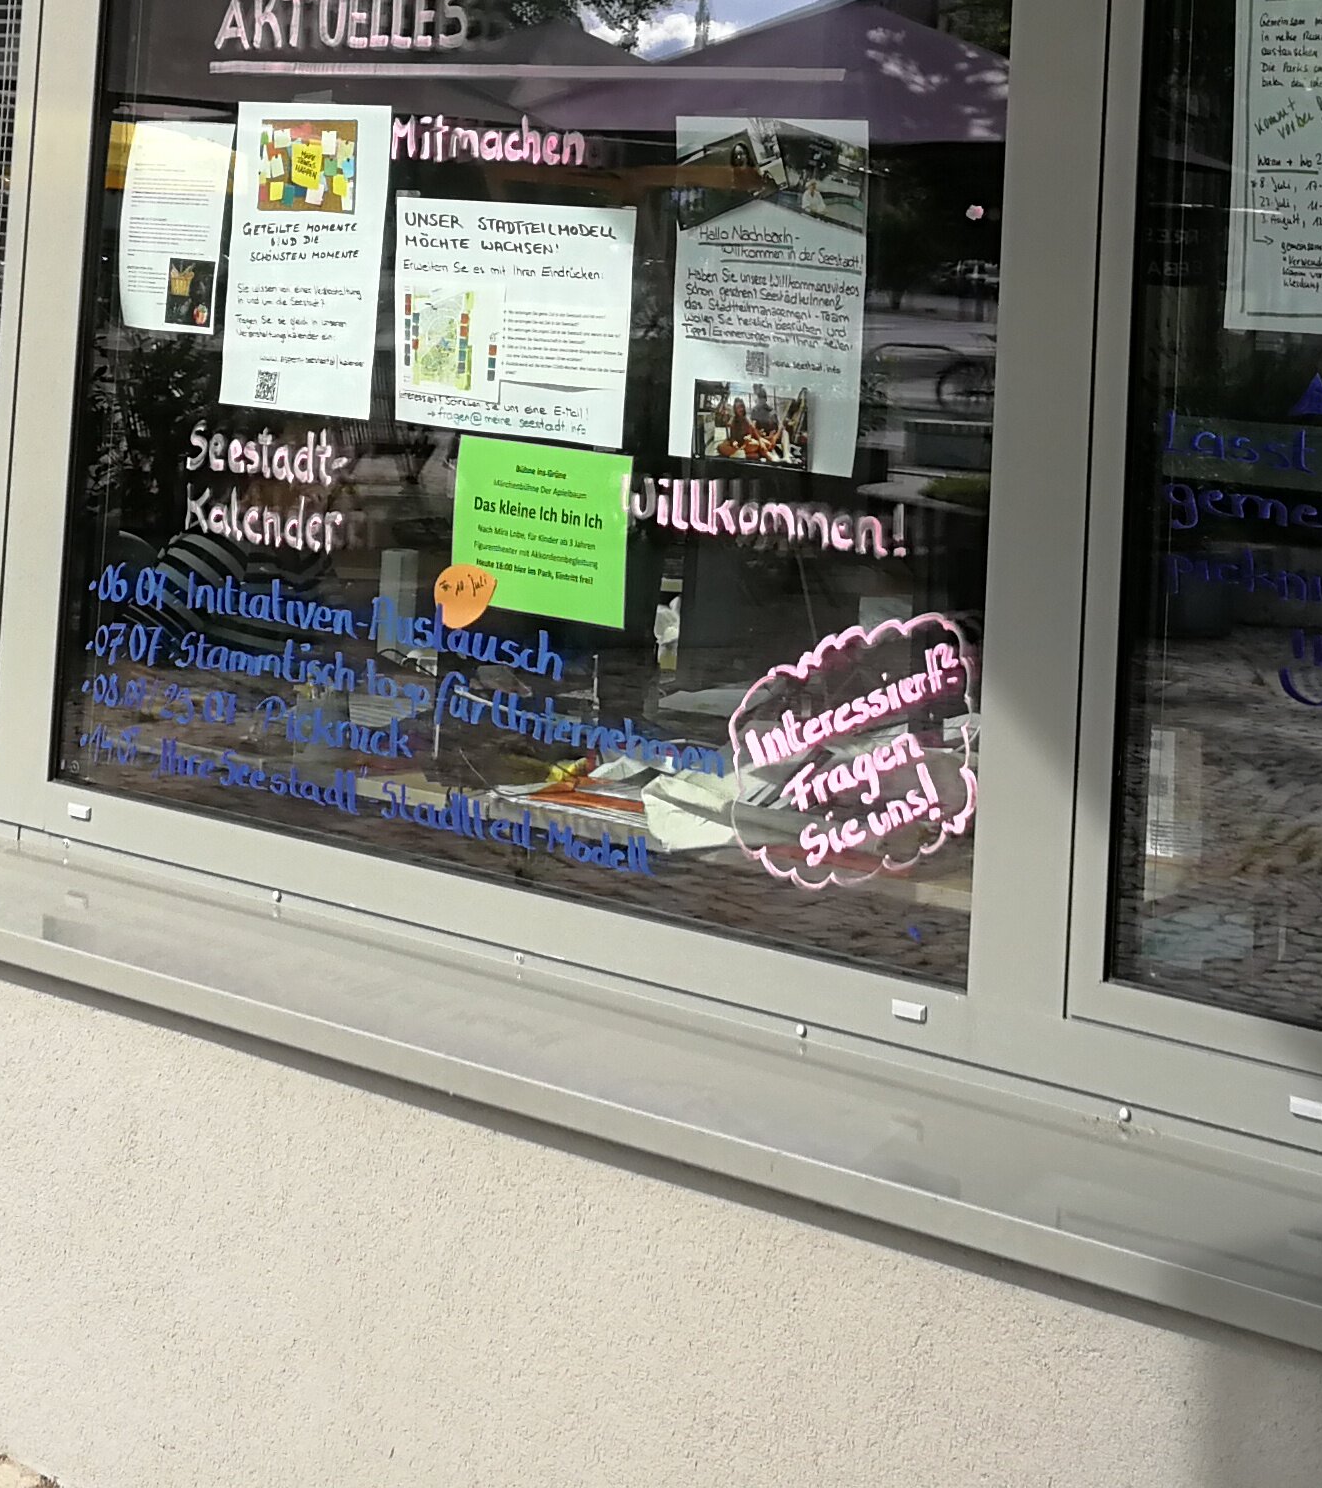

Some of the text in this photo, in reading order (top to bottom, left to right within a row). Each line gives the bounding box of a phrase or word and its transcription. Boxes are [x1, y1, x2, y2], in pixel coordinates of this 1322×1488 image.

[390, 115, 585, 166] Mitmachen
[243, 222, 358, 236] GETEILTE MOMENTE
[311, 250, 359, 259] MOMENTE
[404, 212, 617, 240] UNSER STADTTEILMODELL
[405, 233, 559, 255] MÖCHTE WACHSEN!
[699, 225, 728, 241] Hallo
[799, 248, 815, 261] der
[186, 419, 349, 486] Seestadt-
[1164, 410, 1314, 473] Lasst
[184, 482, 342, 554] Kalender
[474, 496, 603, 530] Das kleine Ich bin Ich
[621, 473, 907, 557] Willkommen!
[187, 571, 564, 682] Initiativen-Austausch
[746, 643, 959, 768] Interessiert?
[781, 733, 925, 812] Fragen
[799, 764, 941, 867] Sie uns!
